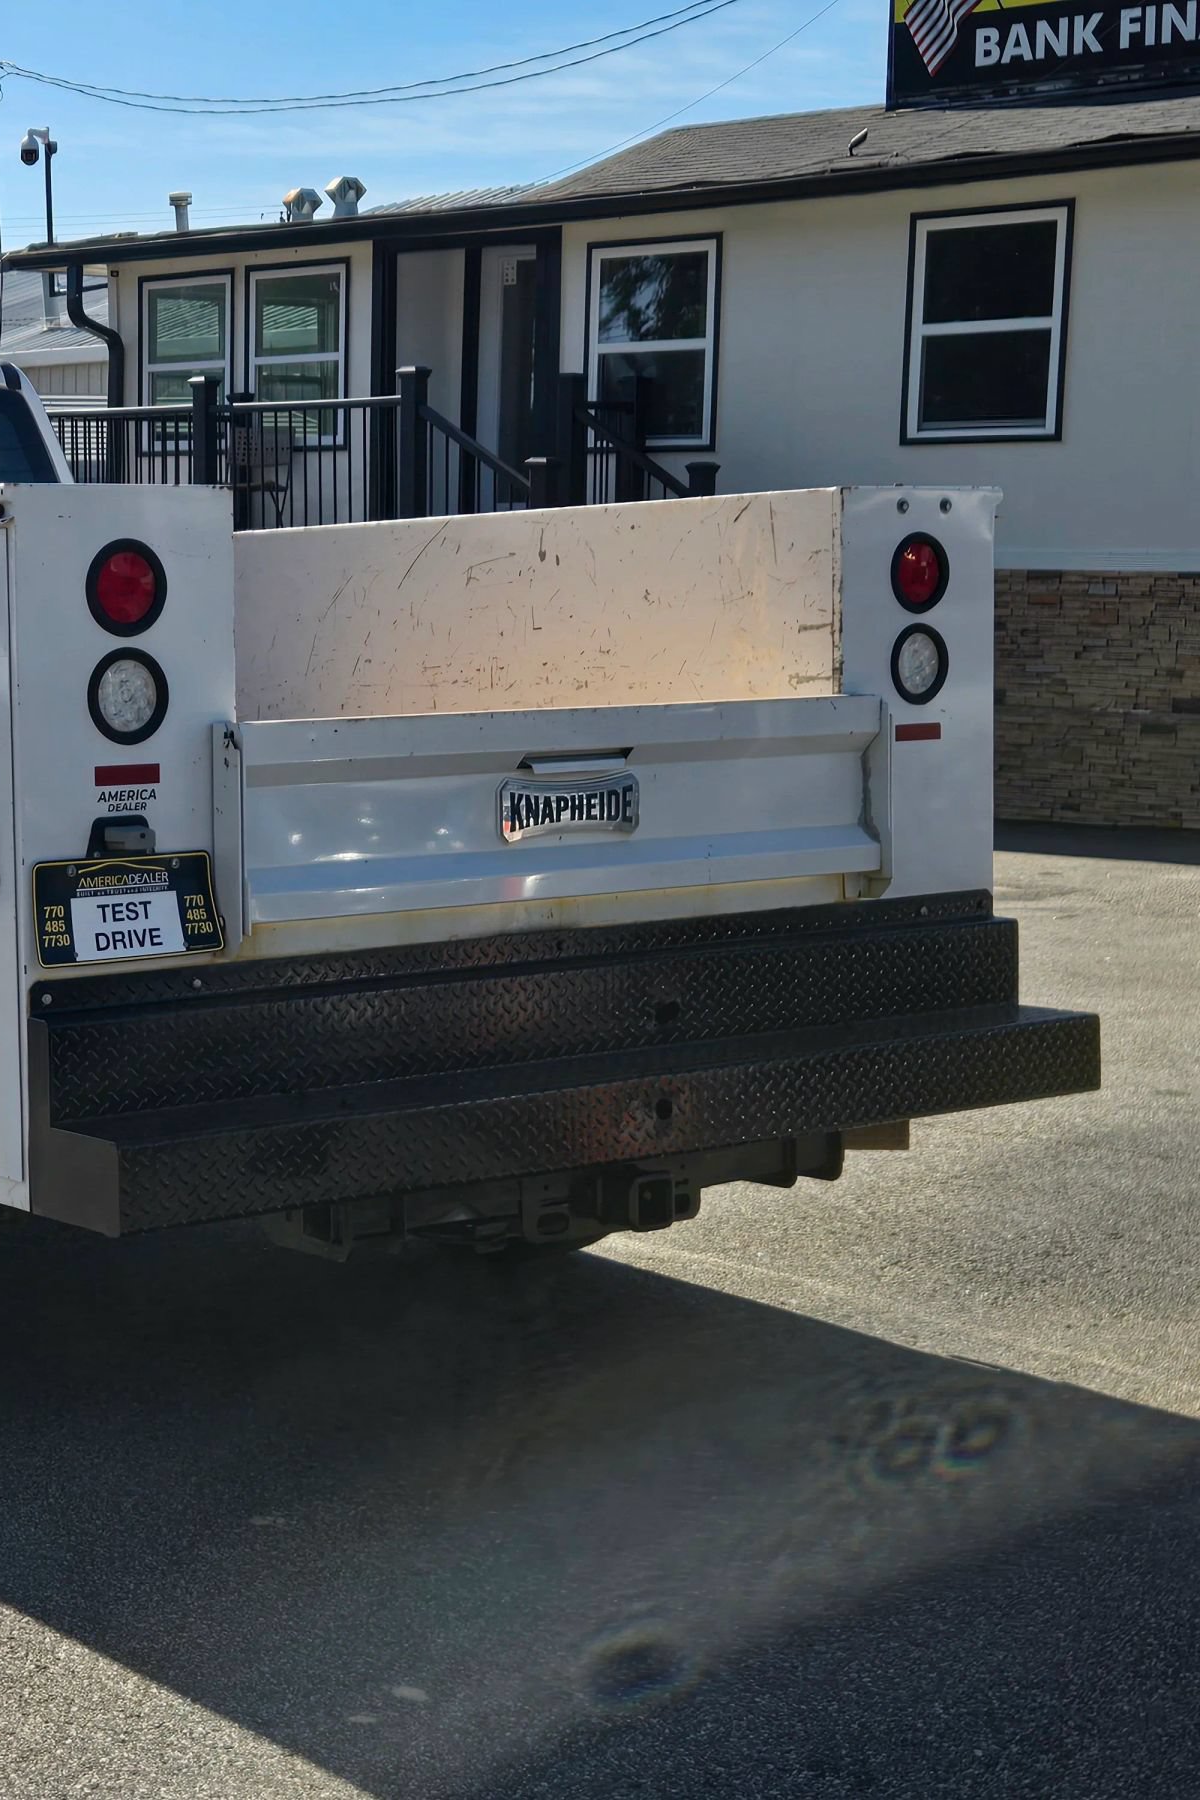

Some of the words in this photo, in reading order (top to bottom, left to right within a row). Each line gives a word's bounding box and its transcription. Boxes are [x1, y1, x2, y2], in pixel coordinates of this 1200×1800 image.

[975, 12, 1104, 67] BANK
[1119, 0, 1200, 49] FIN
[97, 789, 156, 803] AMERICA
[108, 802, 147, 812] DEALER
[509, 784, 633, 833] KNAPHEIDE
[184, 894, 204, 907] 770
[43, 905, 64, 918] 770
[97, 901, 152, 923] TEST
[186, 908, 207, 920] 485
[45, 920, 65, 932] 485
[185, 922, 213, 935] 7730
[43, 935, 70, 948] 7730
[95, 928, 163, 951] DRIVE
